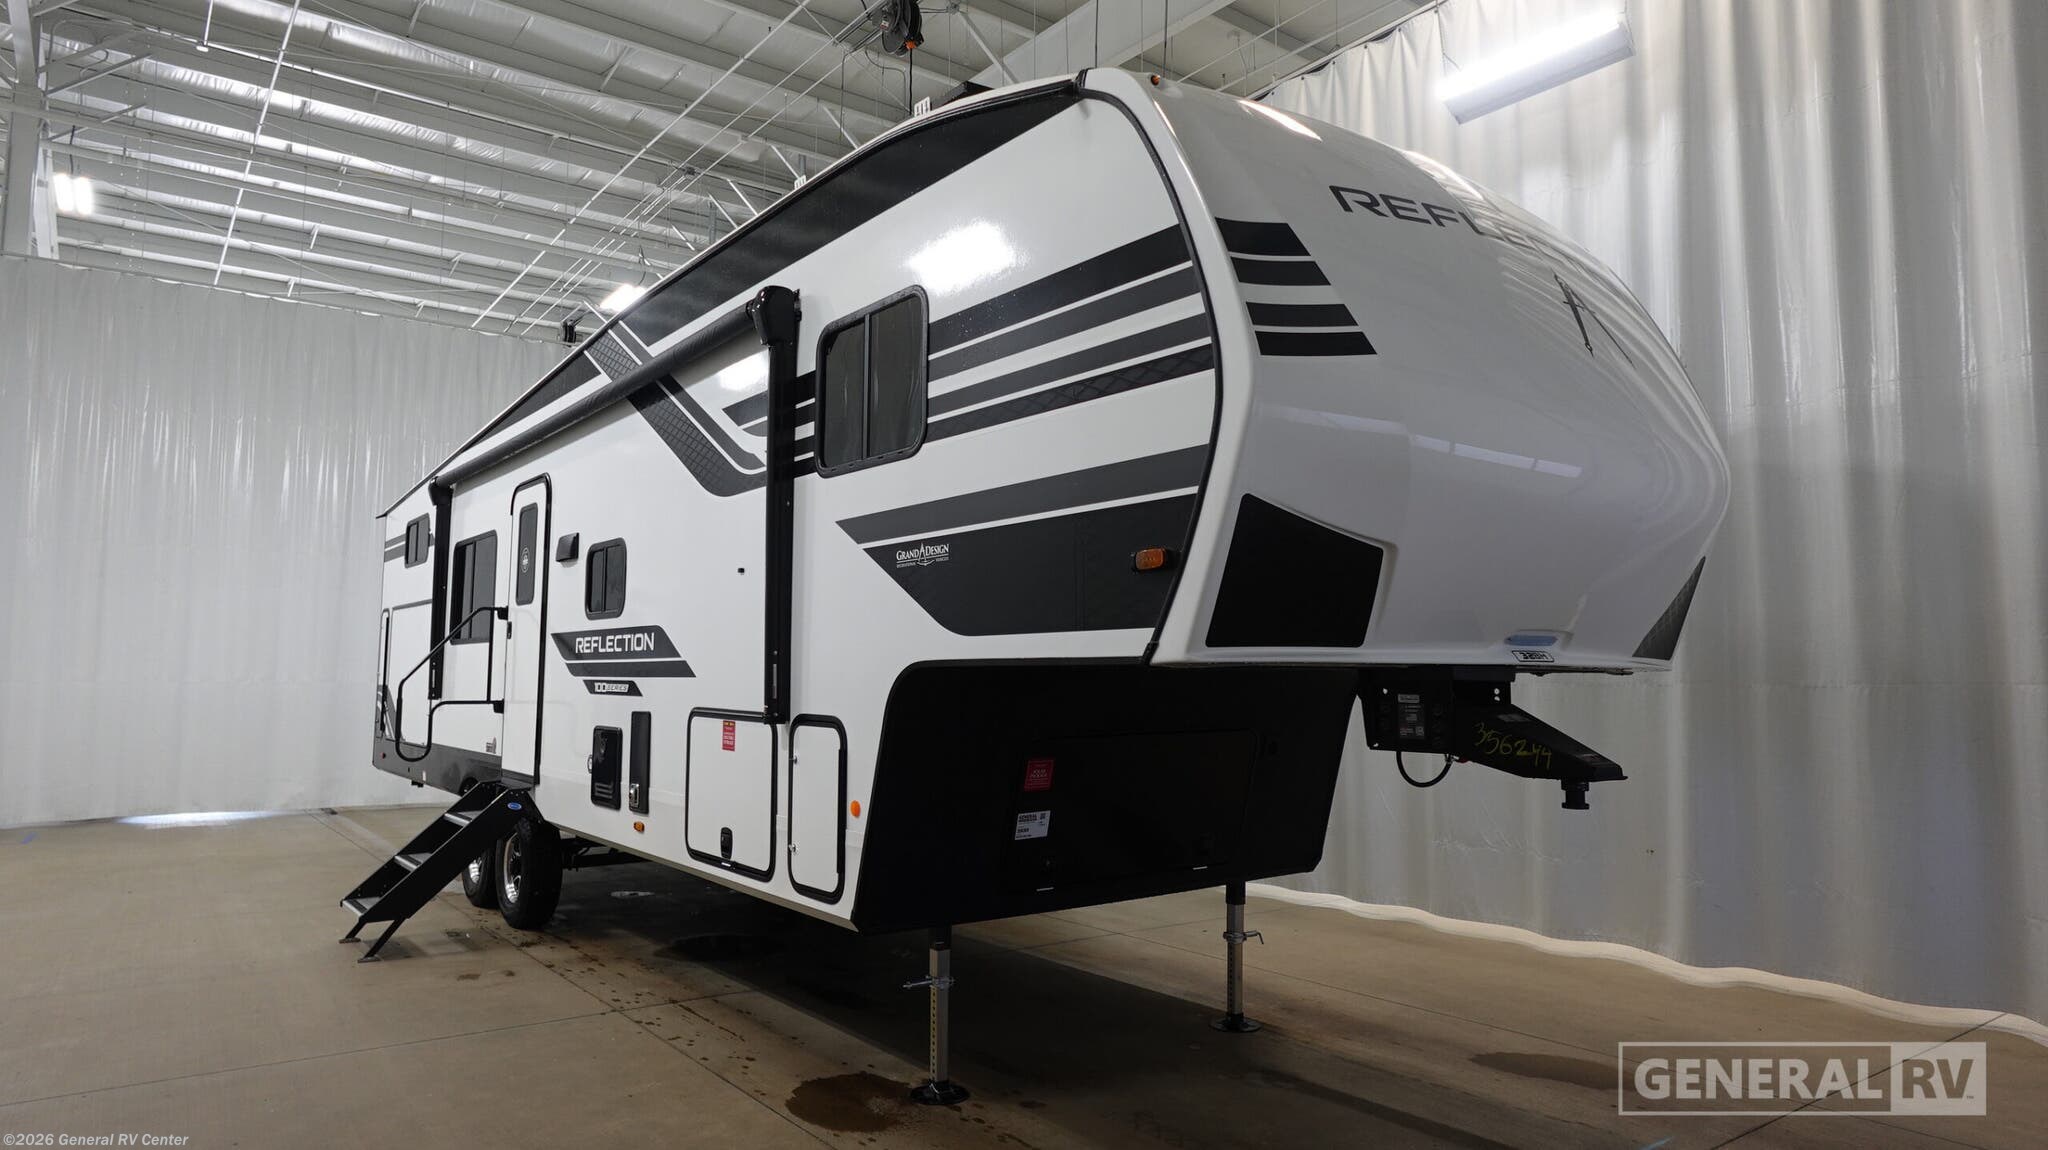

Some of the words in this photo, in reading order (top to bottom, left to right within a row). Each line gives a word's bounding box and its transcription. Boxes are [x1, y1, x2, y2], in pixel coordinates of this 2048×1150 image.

[896, 549, 920, 561] GRAND
[925, 543, 949, 556] DESIGN
[575, 632, 655, 654] REFLECTION
